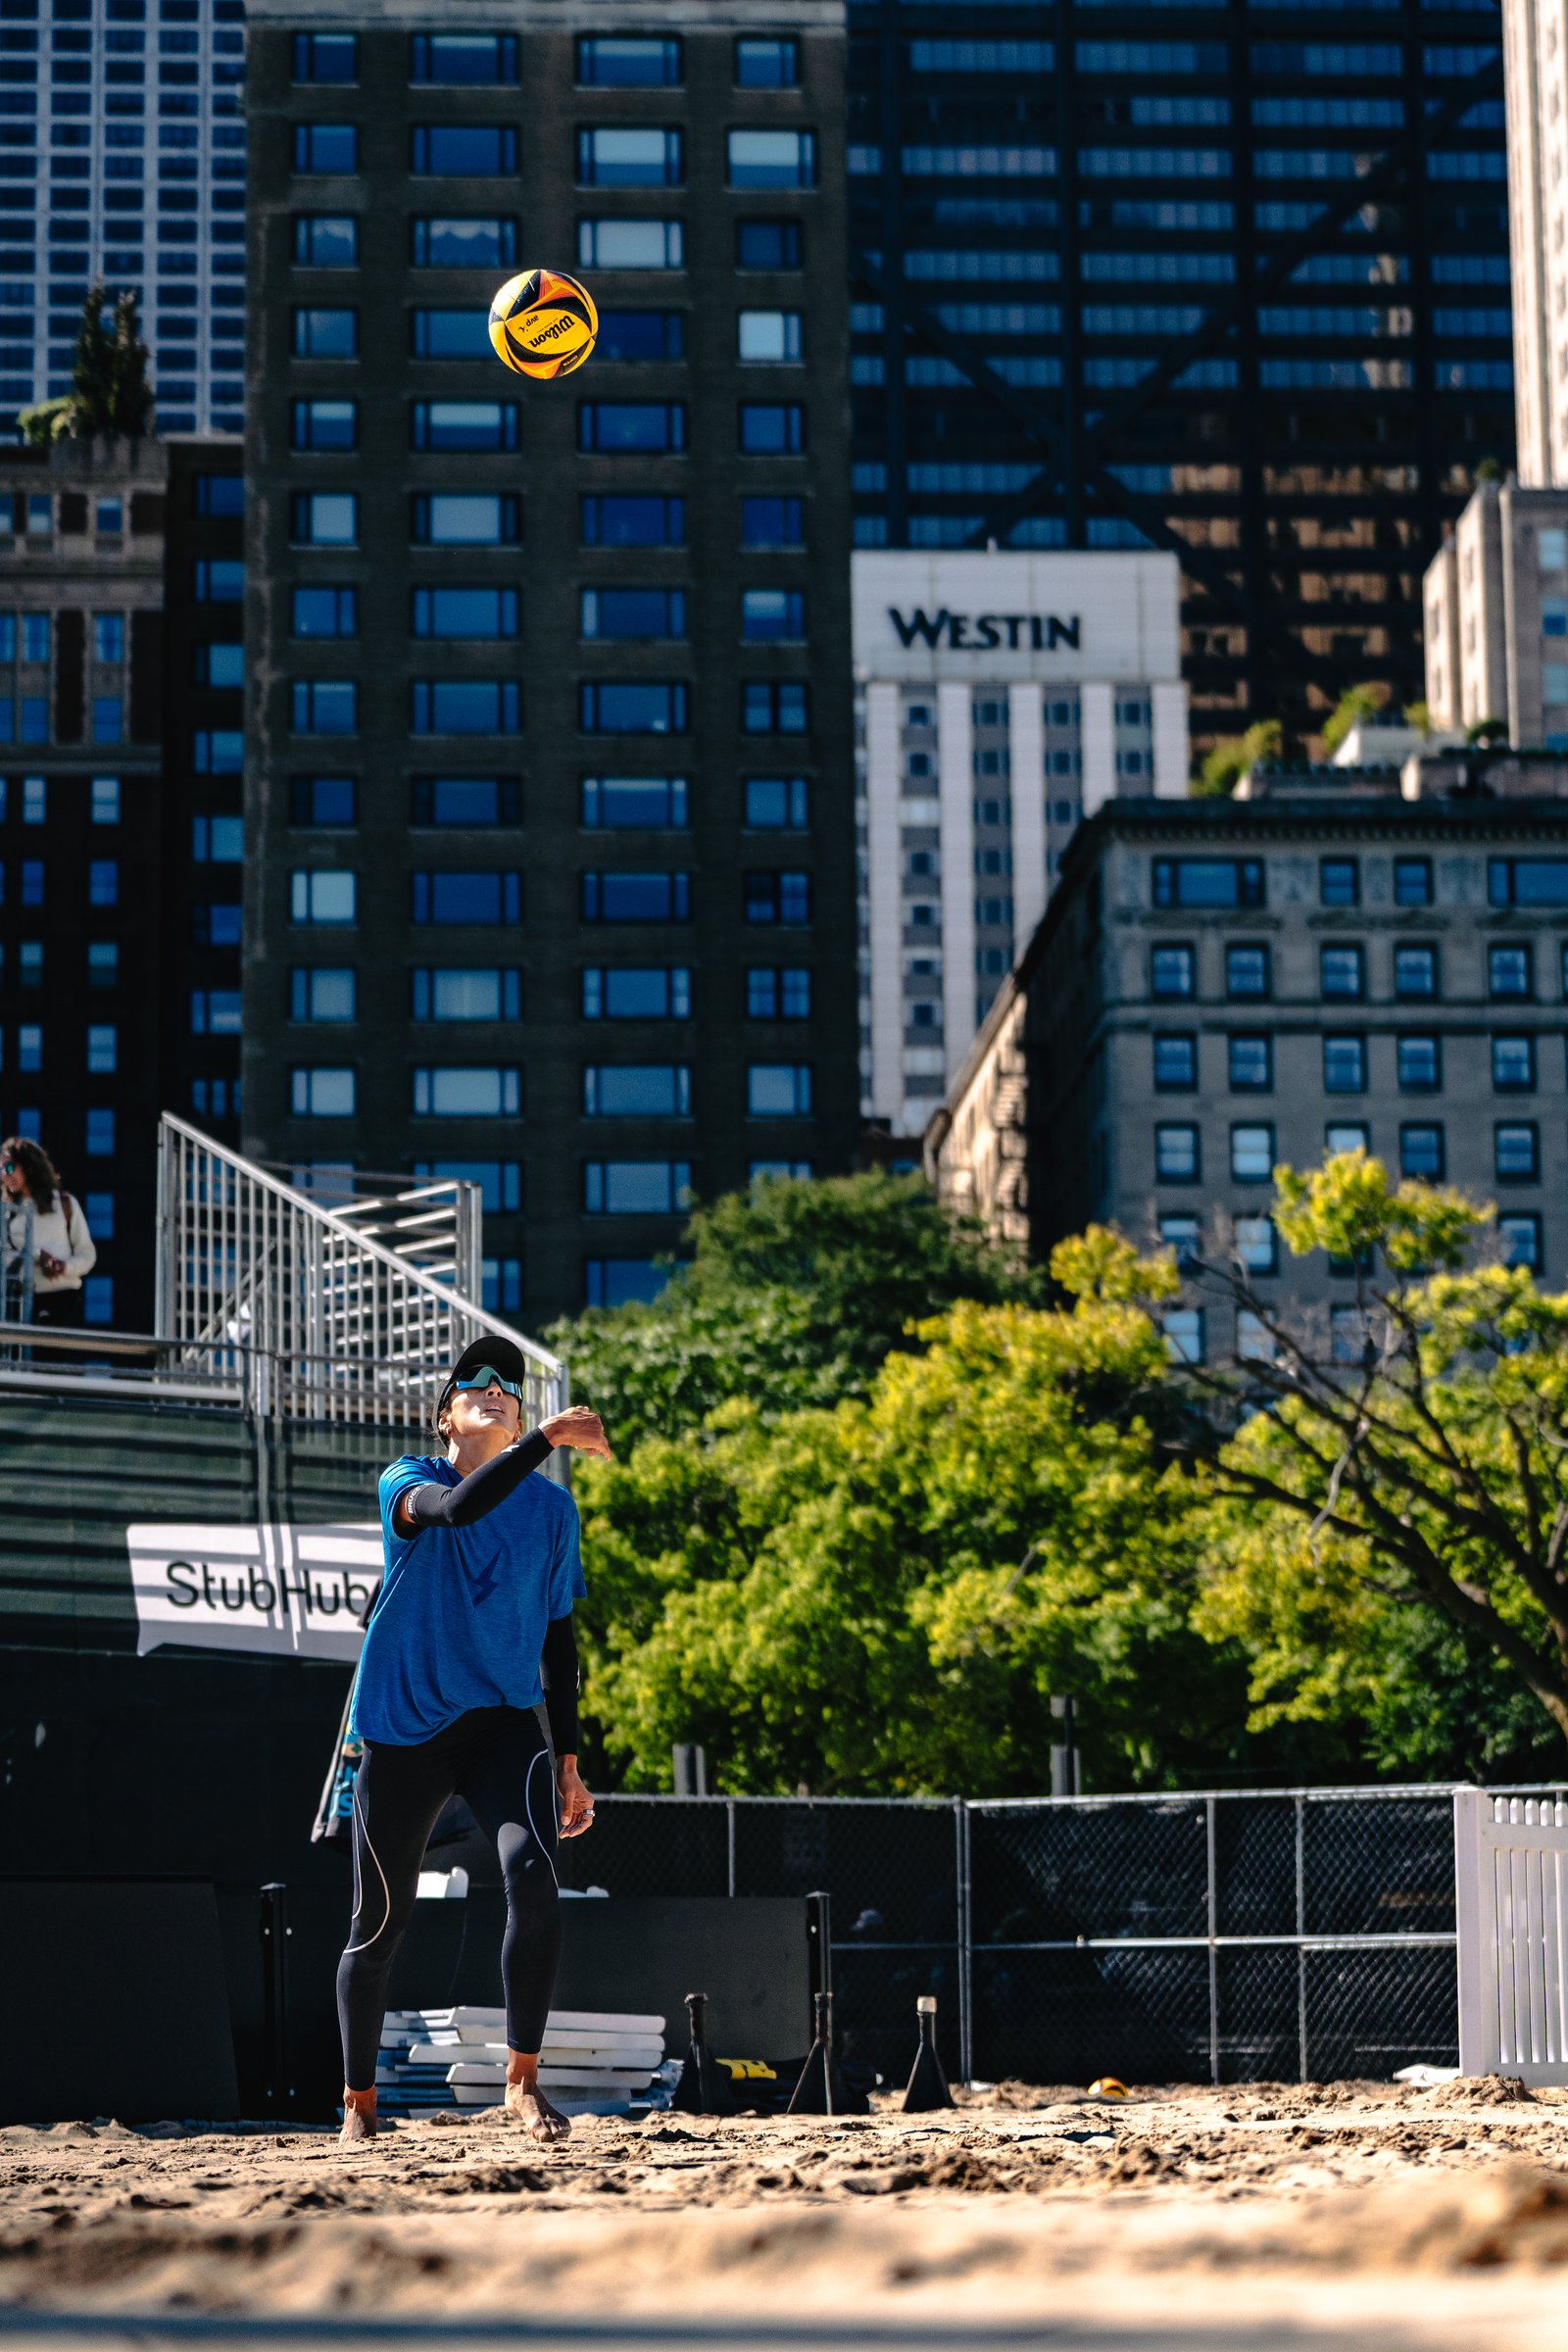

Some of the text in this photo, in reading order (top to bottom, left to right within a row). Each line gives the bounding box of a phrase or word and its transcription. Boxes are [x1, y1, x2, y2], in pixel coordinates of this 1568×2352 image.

[526, 315, 540, 327] avp
[527, 315, 576, 348] Wilson
[166, 1561, 369, 1616] StubHub
